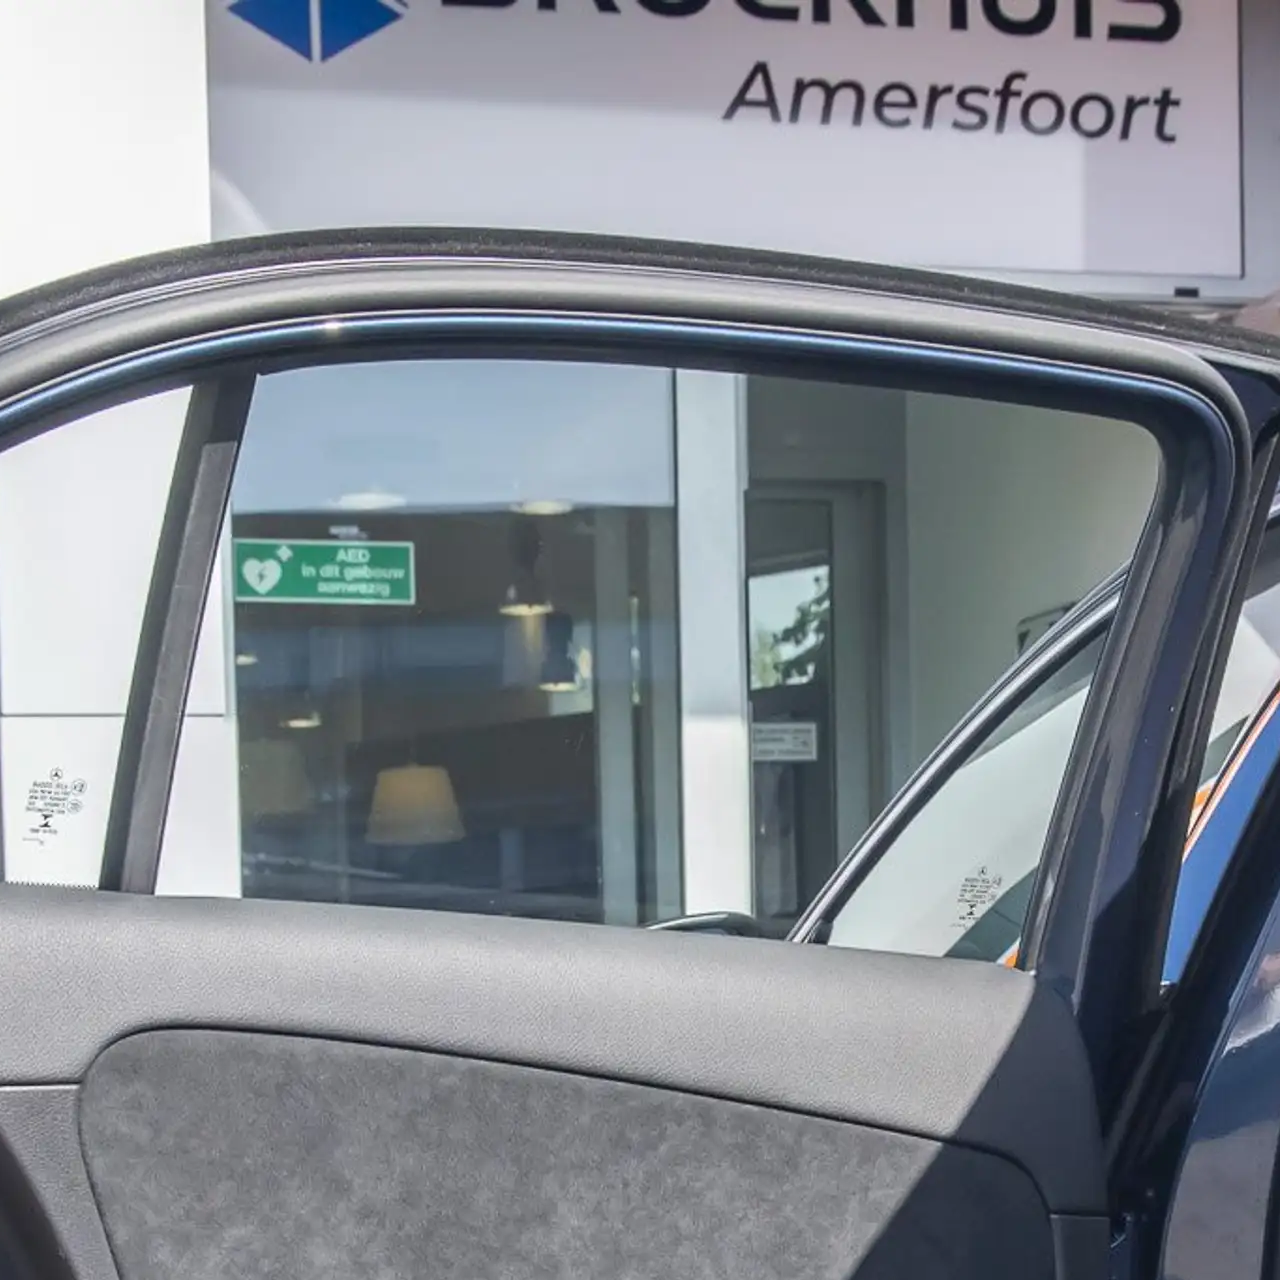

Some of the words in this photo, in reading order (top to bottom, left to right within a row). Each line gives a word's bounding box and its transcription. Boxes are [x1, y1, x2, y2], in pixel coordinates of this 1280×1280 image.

[722, 60, 1181, 144] Amersfoort
[336, 548, 371, 563] AED
[319, 564, 340, 578] dit
[343, 564, 405, 581] gebouw
